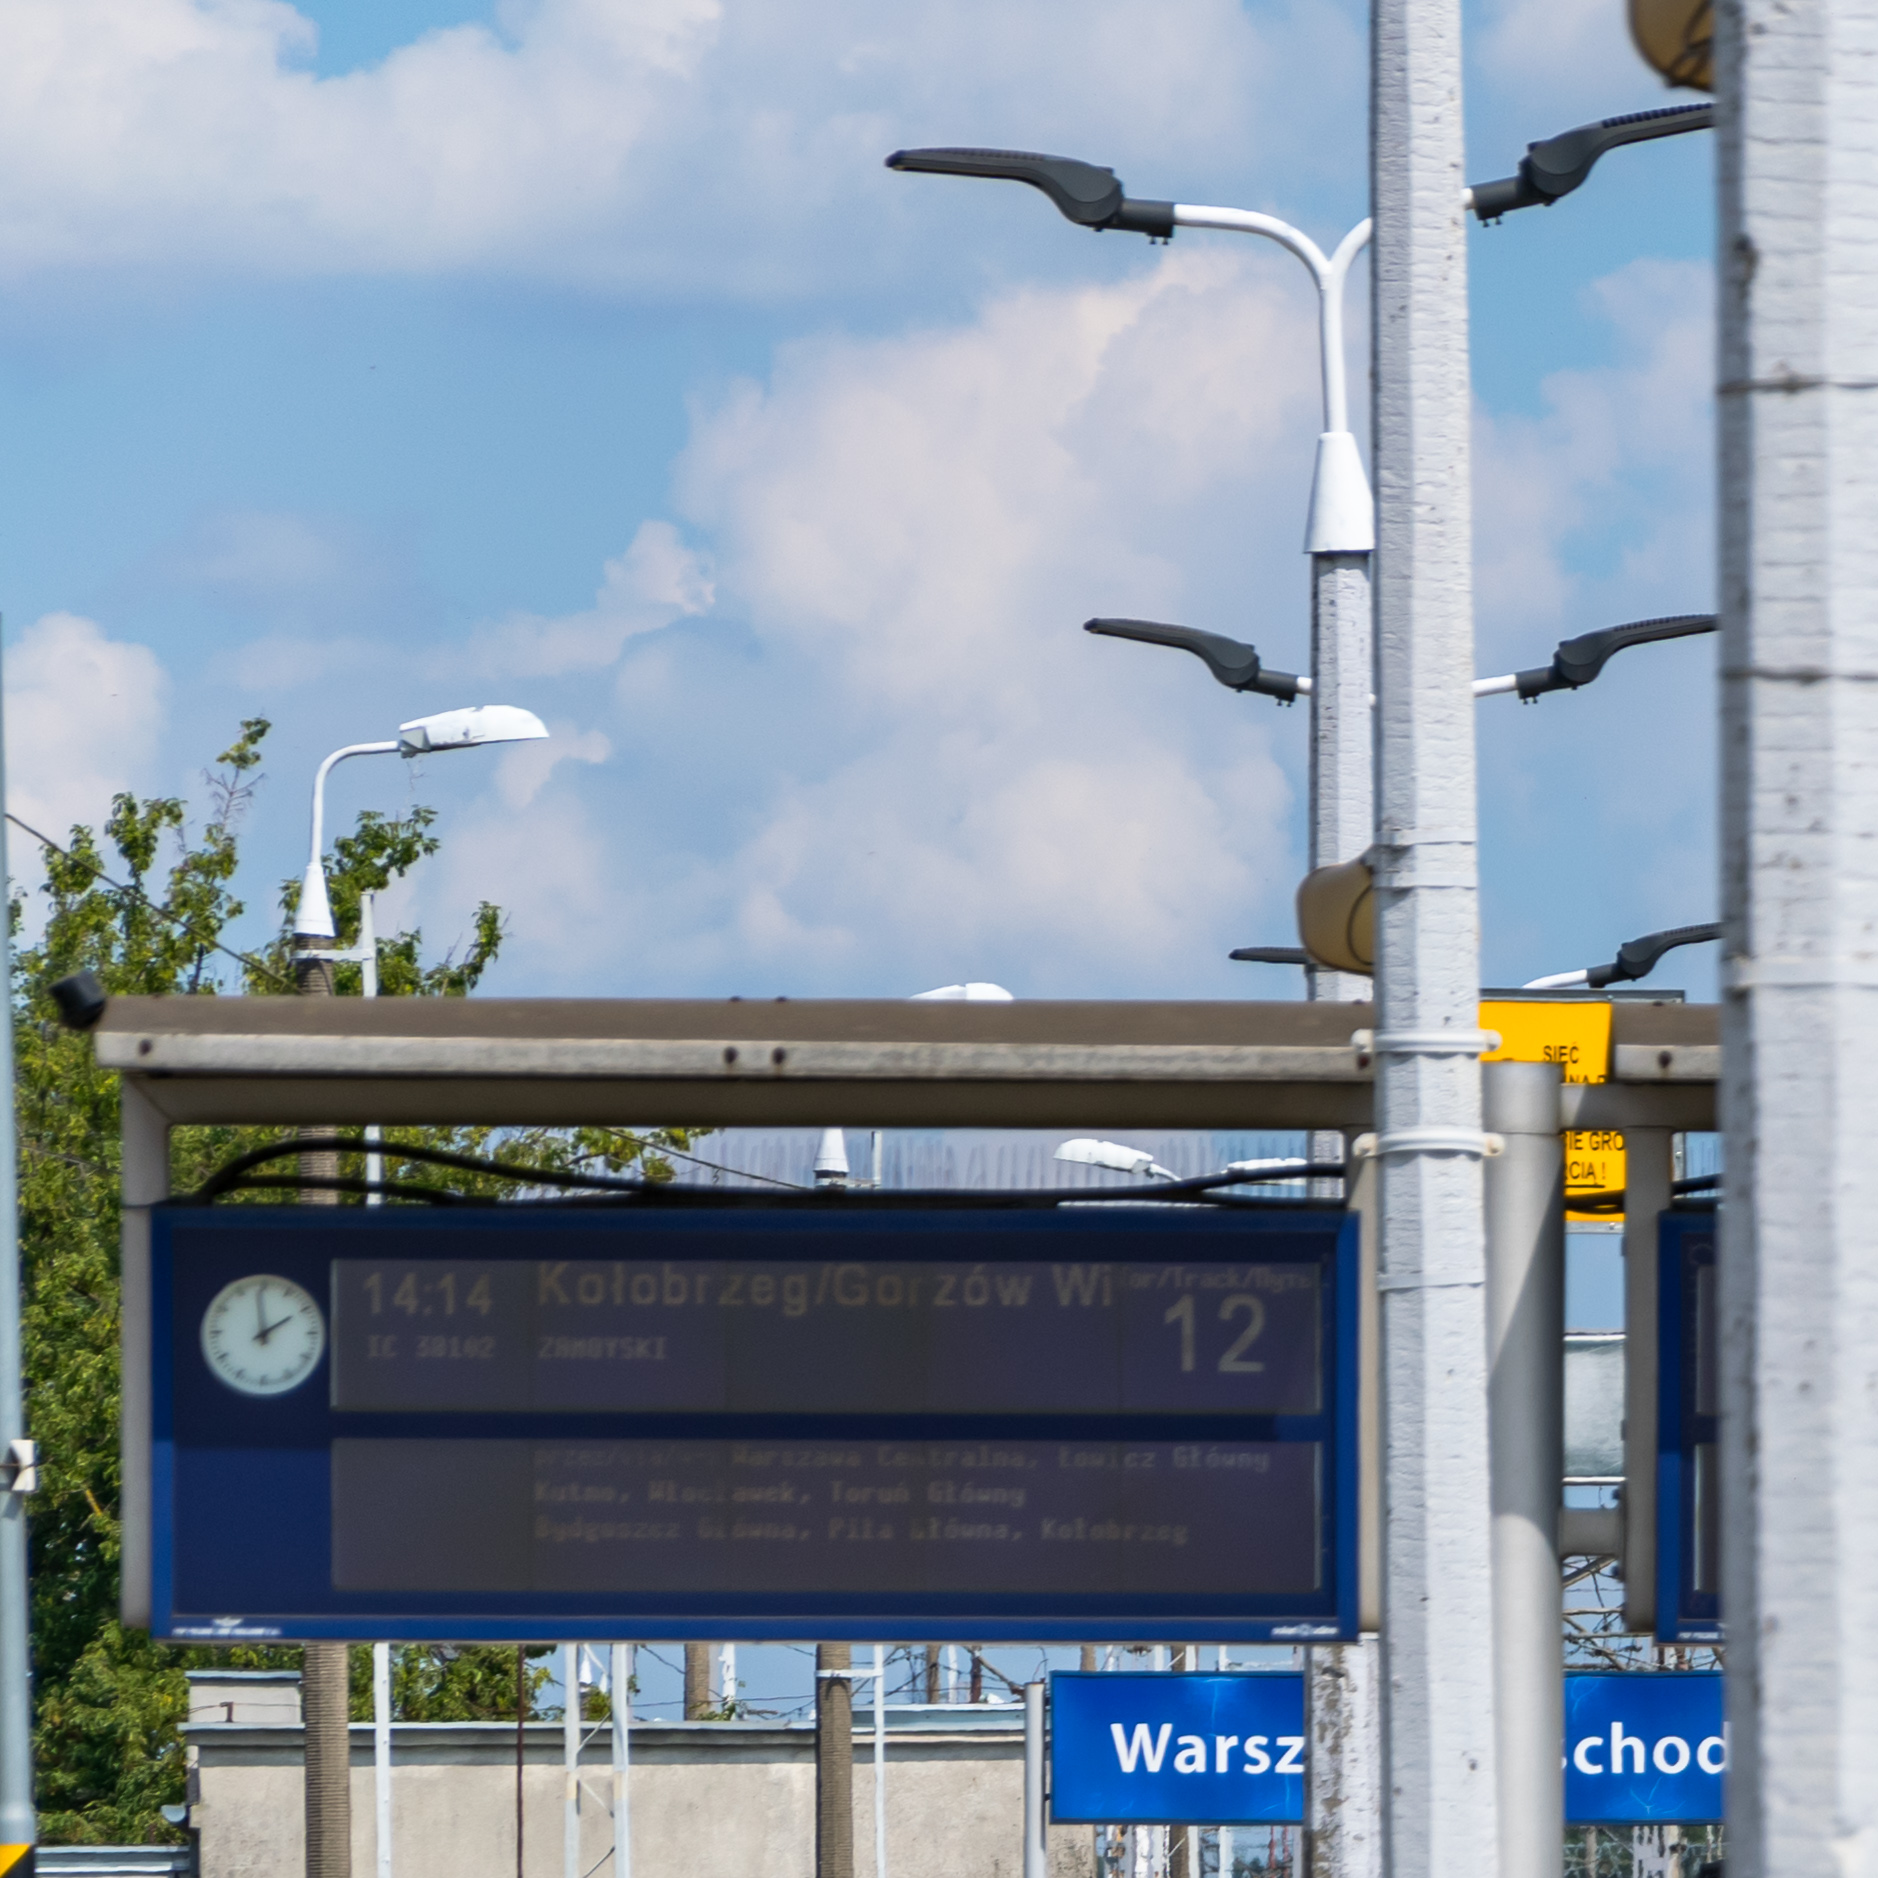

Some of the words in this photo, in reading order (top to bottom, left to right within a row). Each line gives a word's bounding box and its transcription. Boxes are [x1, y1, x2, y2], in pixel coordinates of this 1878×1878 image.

[1543, 1041, 1579, 1064] SIEĆ
[1565, 1161, 1598, 1185] CIĄ
[362, 1271, 493, 1317] 14:14
[538, 1262, 1033, 1318] Kołobrzeg/Gorzów
[1051, 1263, 1113, 1308] Wi
[1164, 1293, 1266, 1374] 12
[1111, 1722, 1304, 1775] Warsz
